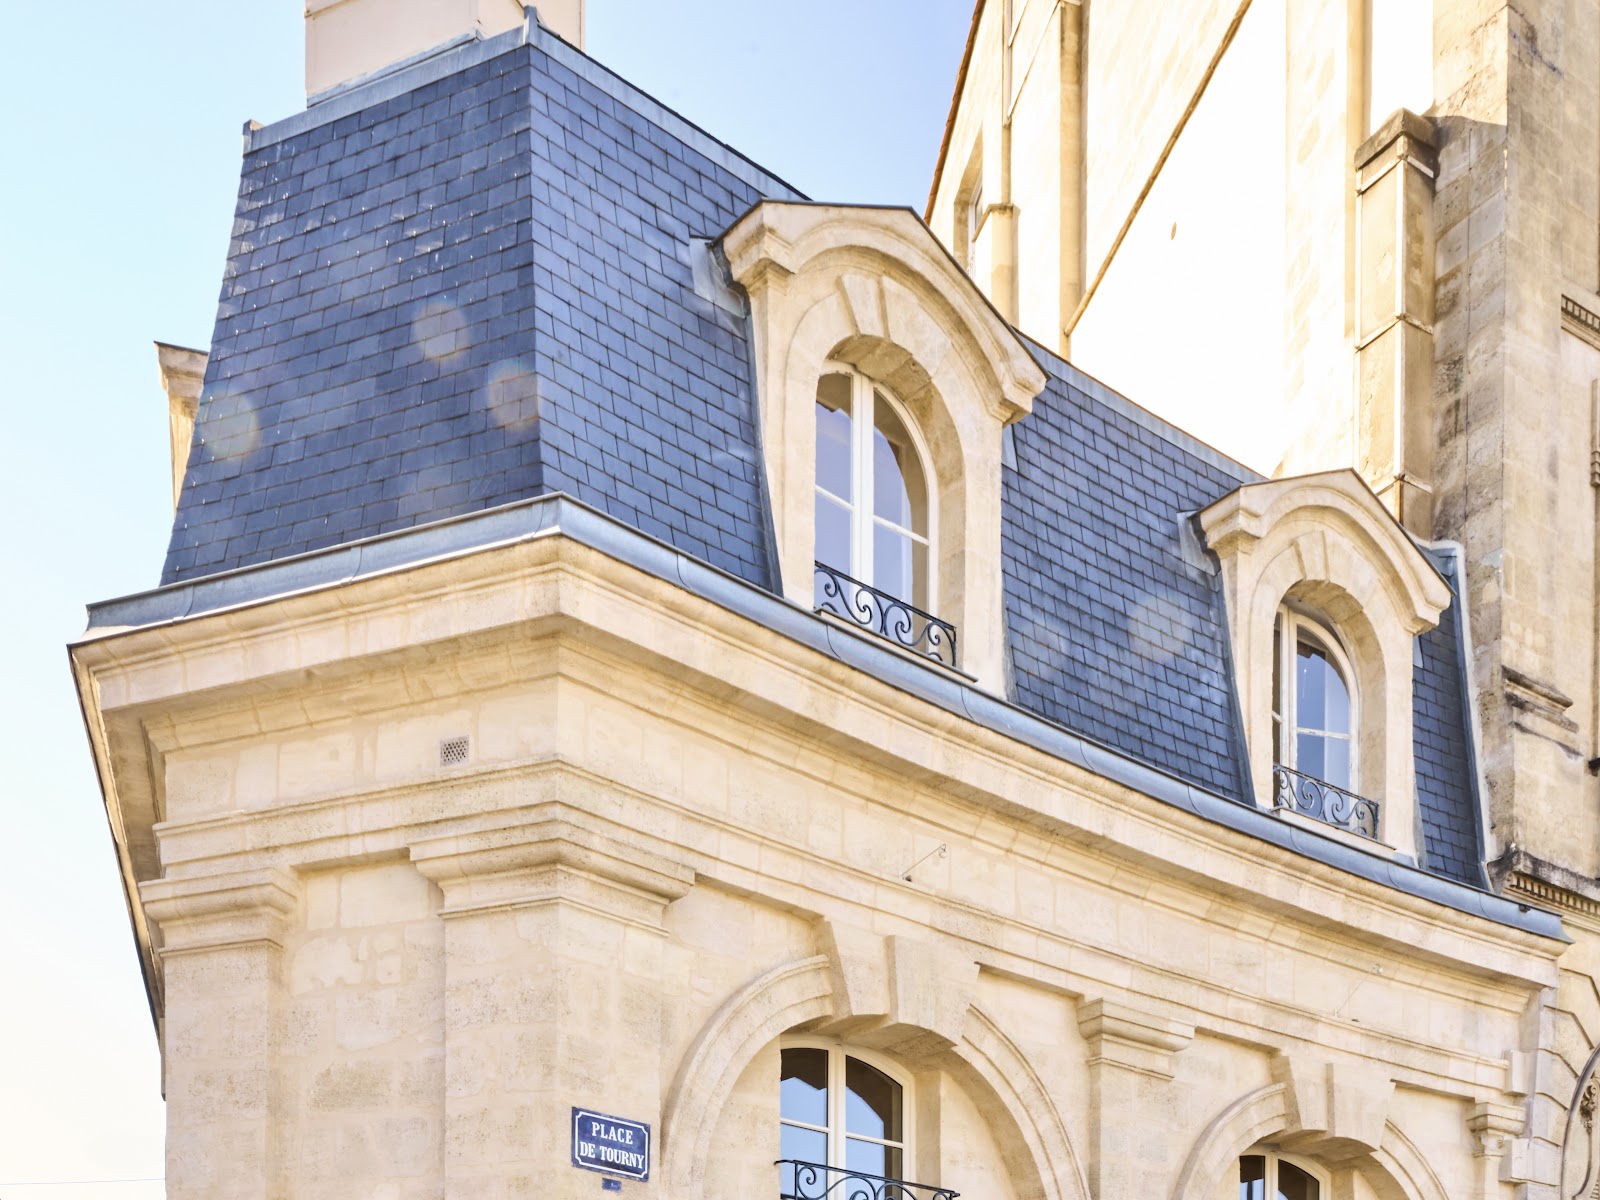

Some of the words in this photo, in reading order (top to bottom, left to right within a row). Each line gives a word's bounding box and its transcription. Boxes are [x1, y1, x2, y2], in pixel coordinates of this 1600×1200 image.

[591, 1121, 634, 1145] PLACE
[580, 1141, 595, 1159] DE
[599, 1145, 645, 1169] TOURNY
